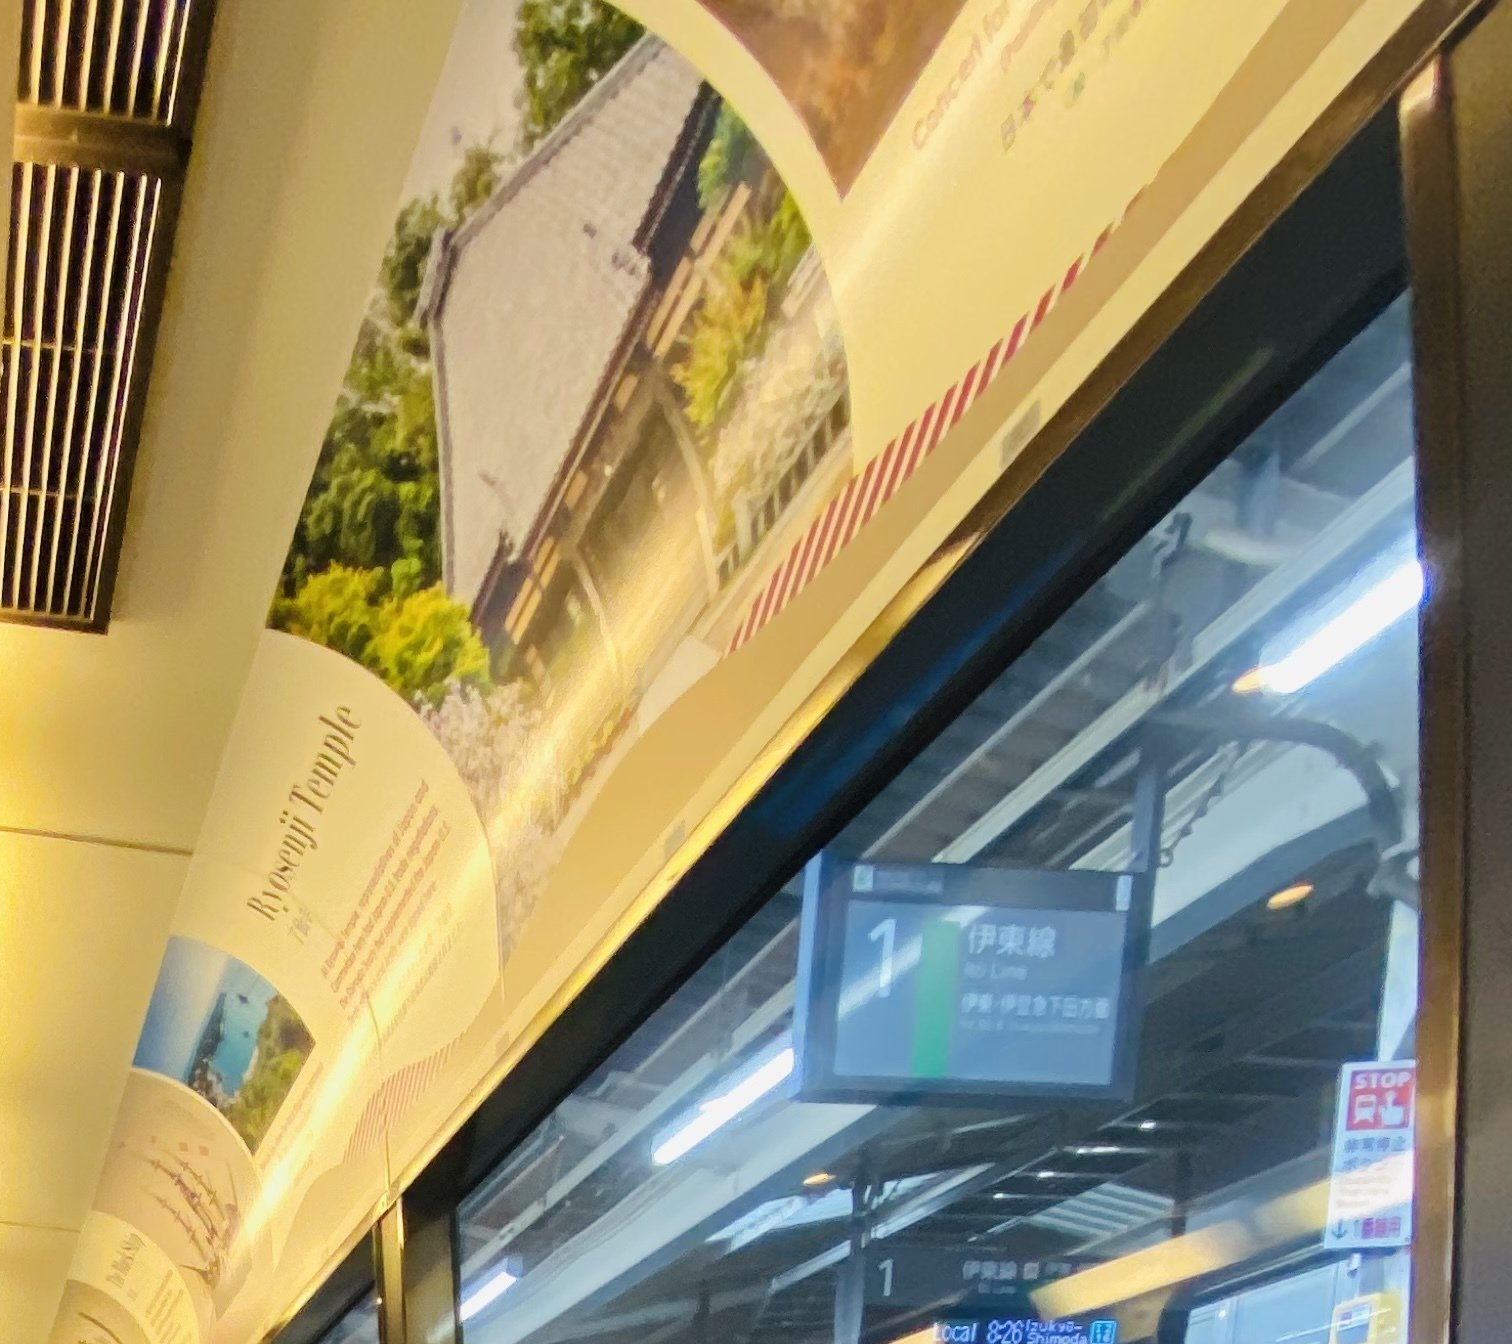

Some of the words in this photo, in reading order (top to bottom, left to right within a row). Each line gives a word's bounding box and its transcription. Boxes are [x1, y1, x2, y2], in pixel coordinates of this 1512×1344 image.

[246, 810, 318, 921] Ryosenji
[289, 705, 361, 813] Temple
[868, 918, 896, 998] 1
[968, 923, 1056, 960] 伊東線
[1354, 1071, 1411, 1090] STOP
[877, 1259, 894, 1297] 1
[932, 1322, 977, 1343] Local
[986, 1320, 1024, 1344] 8:26
